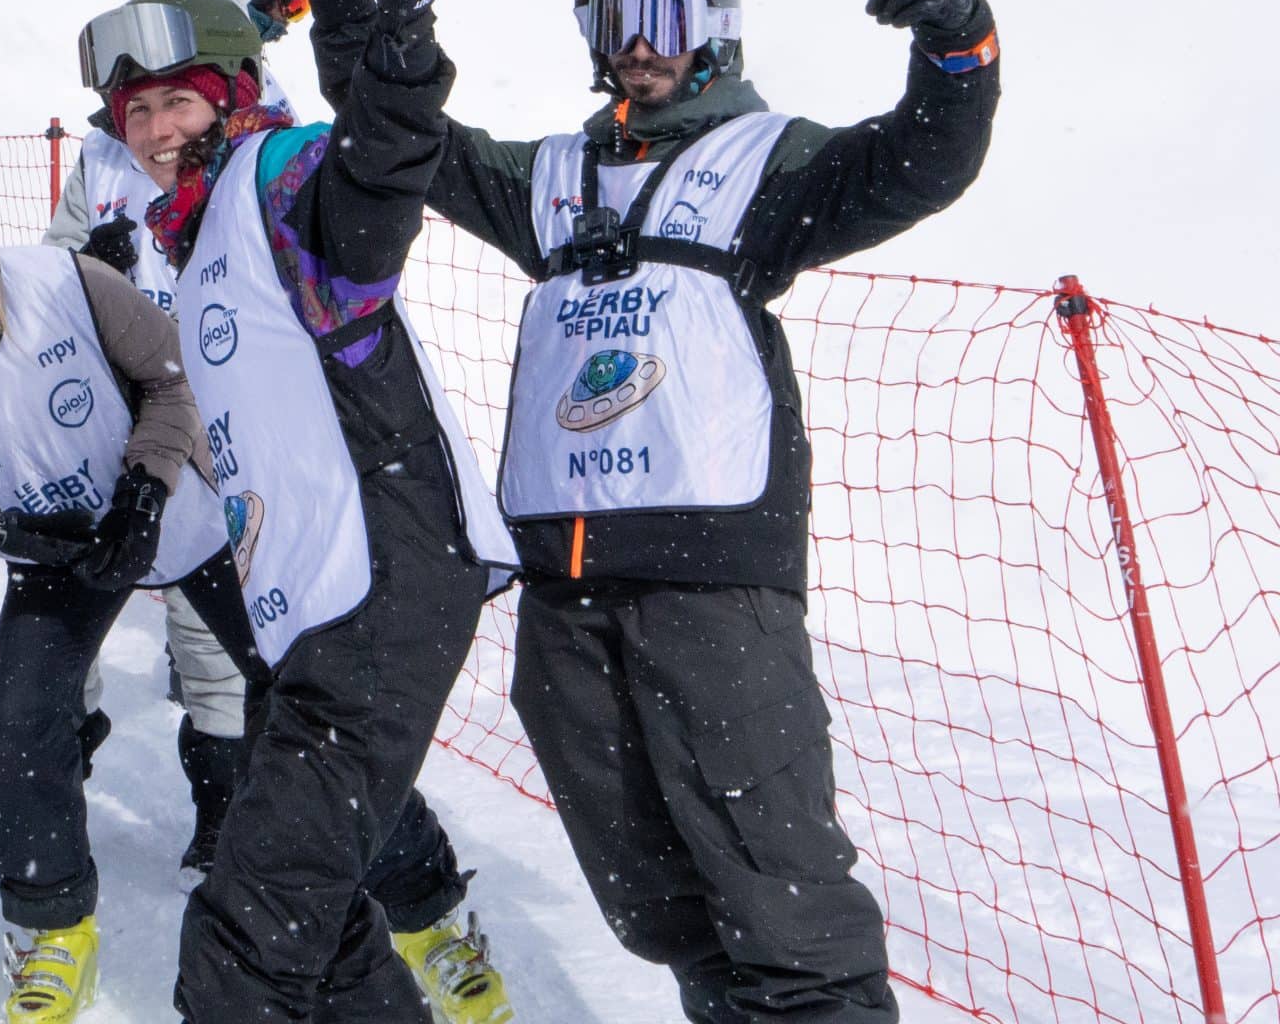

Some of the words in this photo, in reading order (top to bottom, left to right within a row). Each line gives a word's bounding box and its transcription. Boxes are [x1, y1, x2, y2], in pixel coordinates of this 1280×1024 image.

[683, 169, 727, 191] n'py
[200, 254, 228, 285] n'py
[556, 286, 670, 323] DERBY
[204, 322, 231, 349] piau
[565, 319, 586, 338] DE
[586, 314, 651, 341] PIAU
[38, 336, 77, 368] n'py
[57, 389, 88, 419] piau
[568, 446, 650, 478] N°081
[14, 482, 35, 500] LE
[1109, 502, 1136, 609] LISKI
